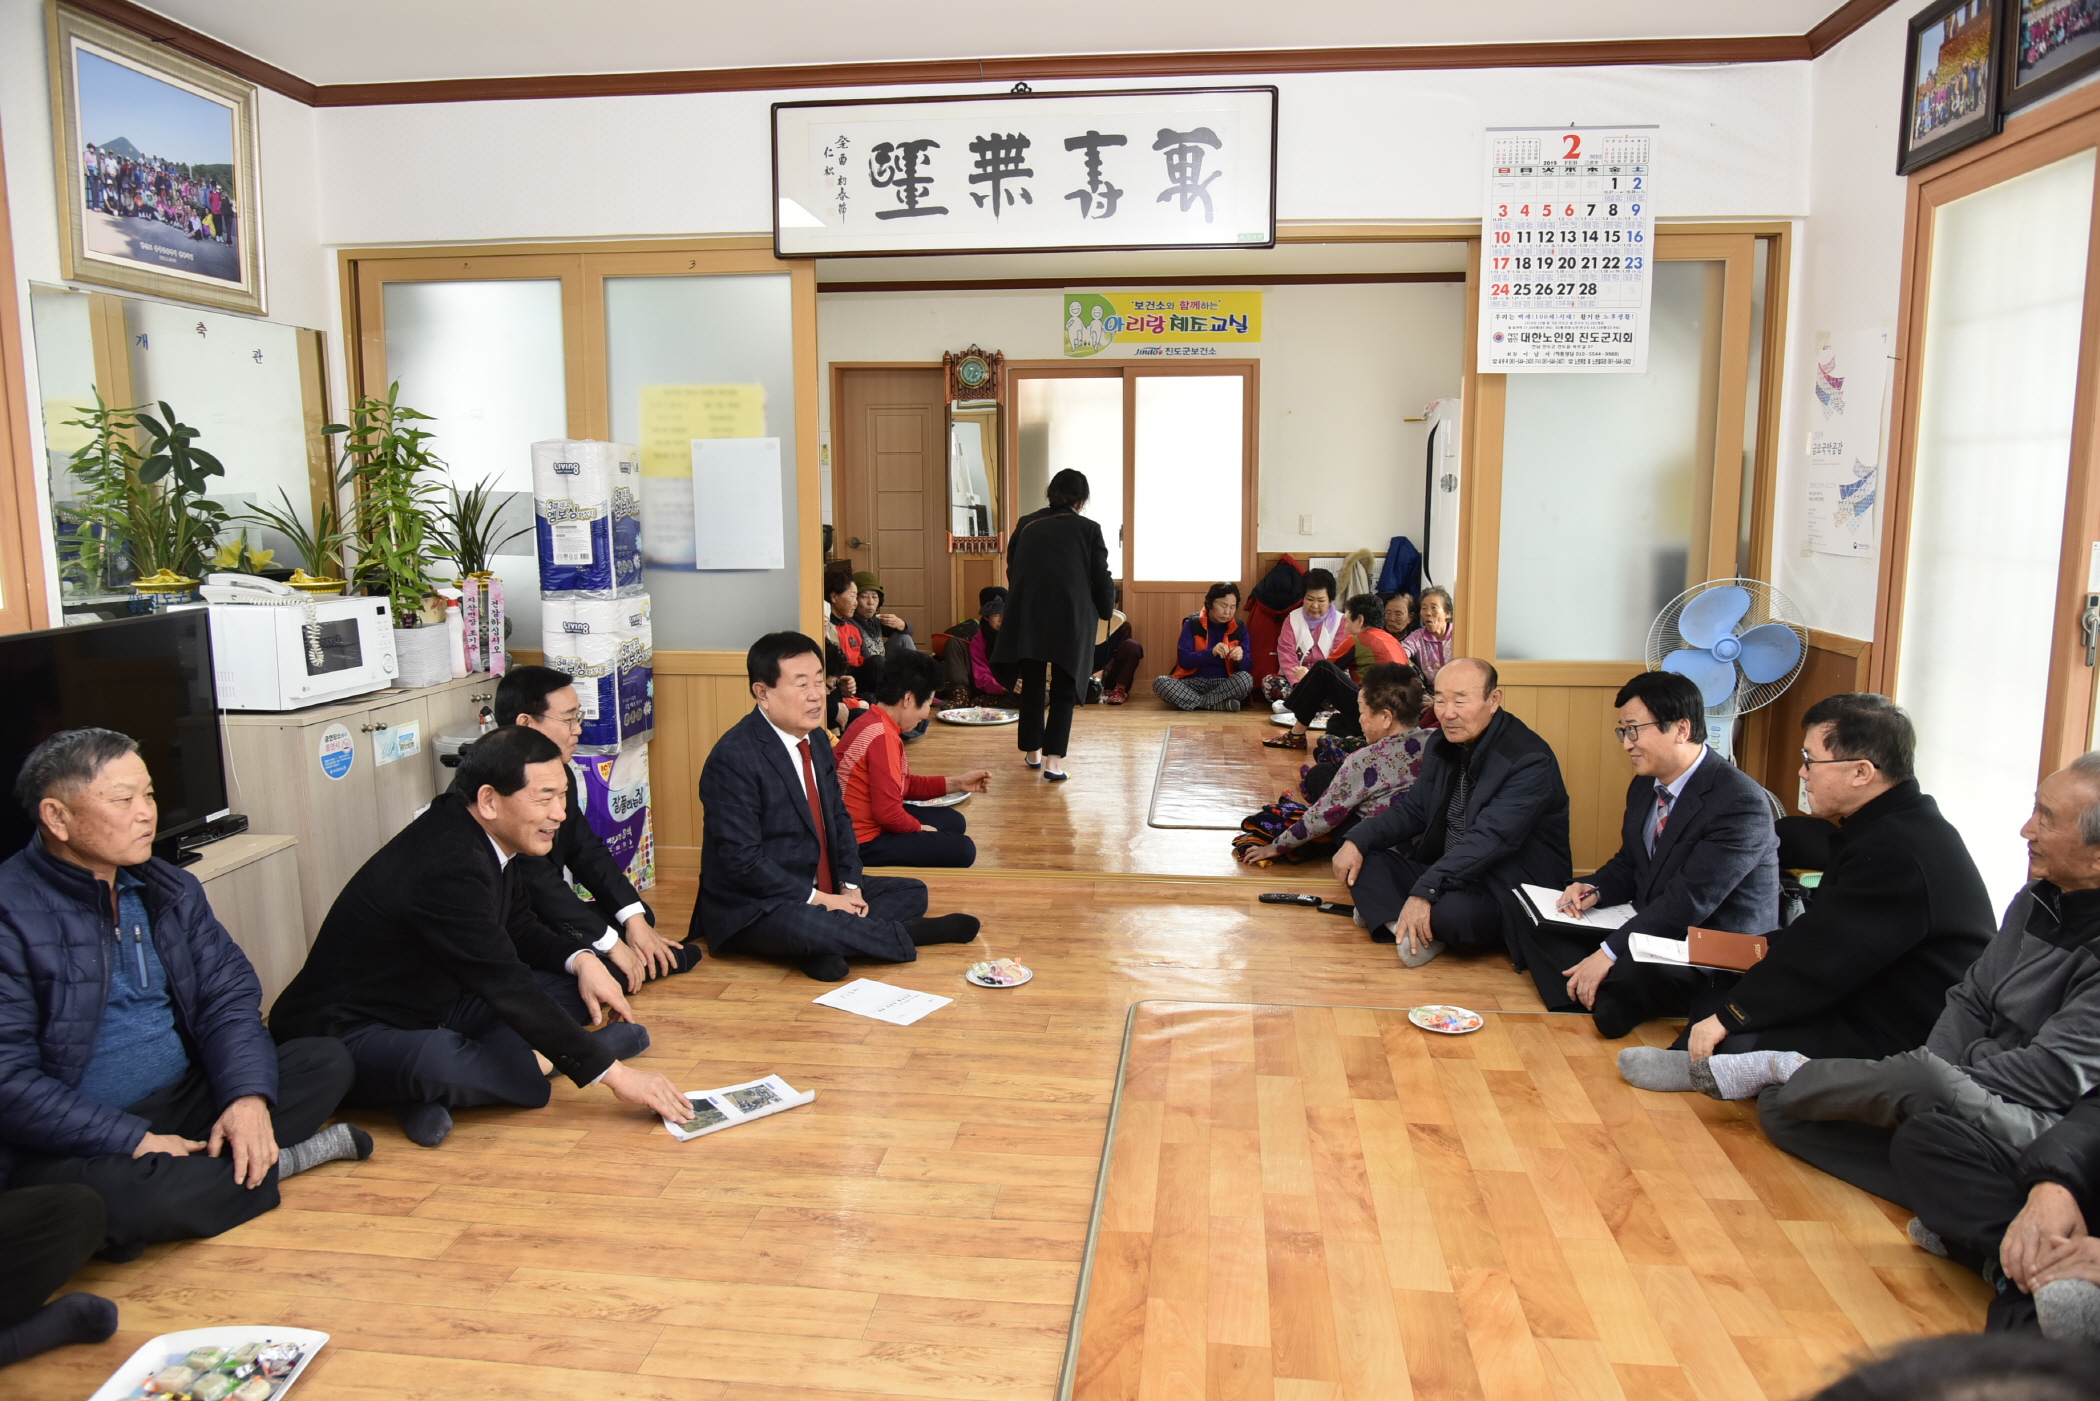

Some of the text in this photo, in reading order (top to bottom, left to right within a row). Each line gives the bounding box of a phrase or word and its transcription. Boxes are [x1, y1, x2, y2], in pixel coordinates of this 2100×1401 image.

[1562, 135, 1581, 159] 2
[1611, 177, 1617, 189] 1
[1633, 177, 1642, 189] 2
[1498, 204, 1640, 217] 3 4 5 6 7 8 9
[1494, 231, 1643, 244] 10 11 12 13 14 15 16
[688, 260, 696, 269] 3
[1493, 257, 1643, 270] 17 18 19 20 21 22 23
[1491, 284, 1510, 296] 24
[1513, 283, 1531, 295] 25
[1535, 283, 1553, 295] 26
[1557, 283, 1576, 295] 27
[1579, 283, 1597, 295] 28
[1104, 314, 1166, 334] 아리랑
[136, 333, 148, 350] 개
[1521, 332, 1633, 343] 대한노인회 진도군지회
[1134, 346, 1217, 356] Jindo 진도군보건소
[547, 508, 578, 523] 엠보싱
[491, 600, 501, 654] 건강하십시오
[612, 786, 644, 814] 잘풀리는집
